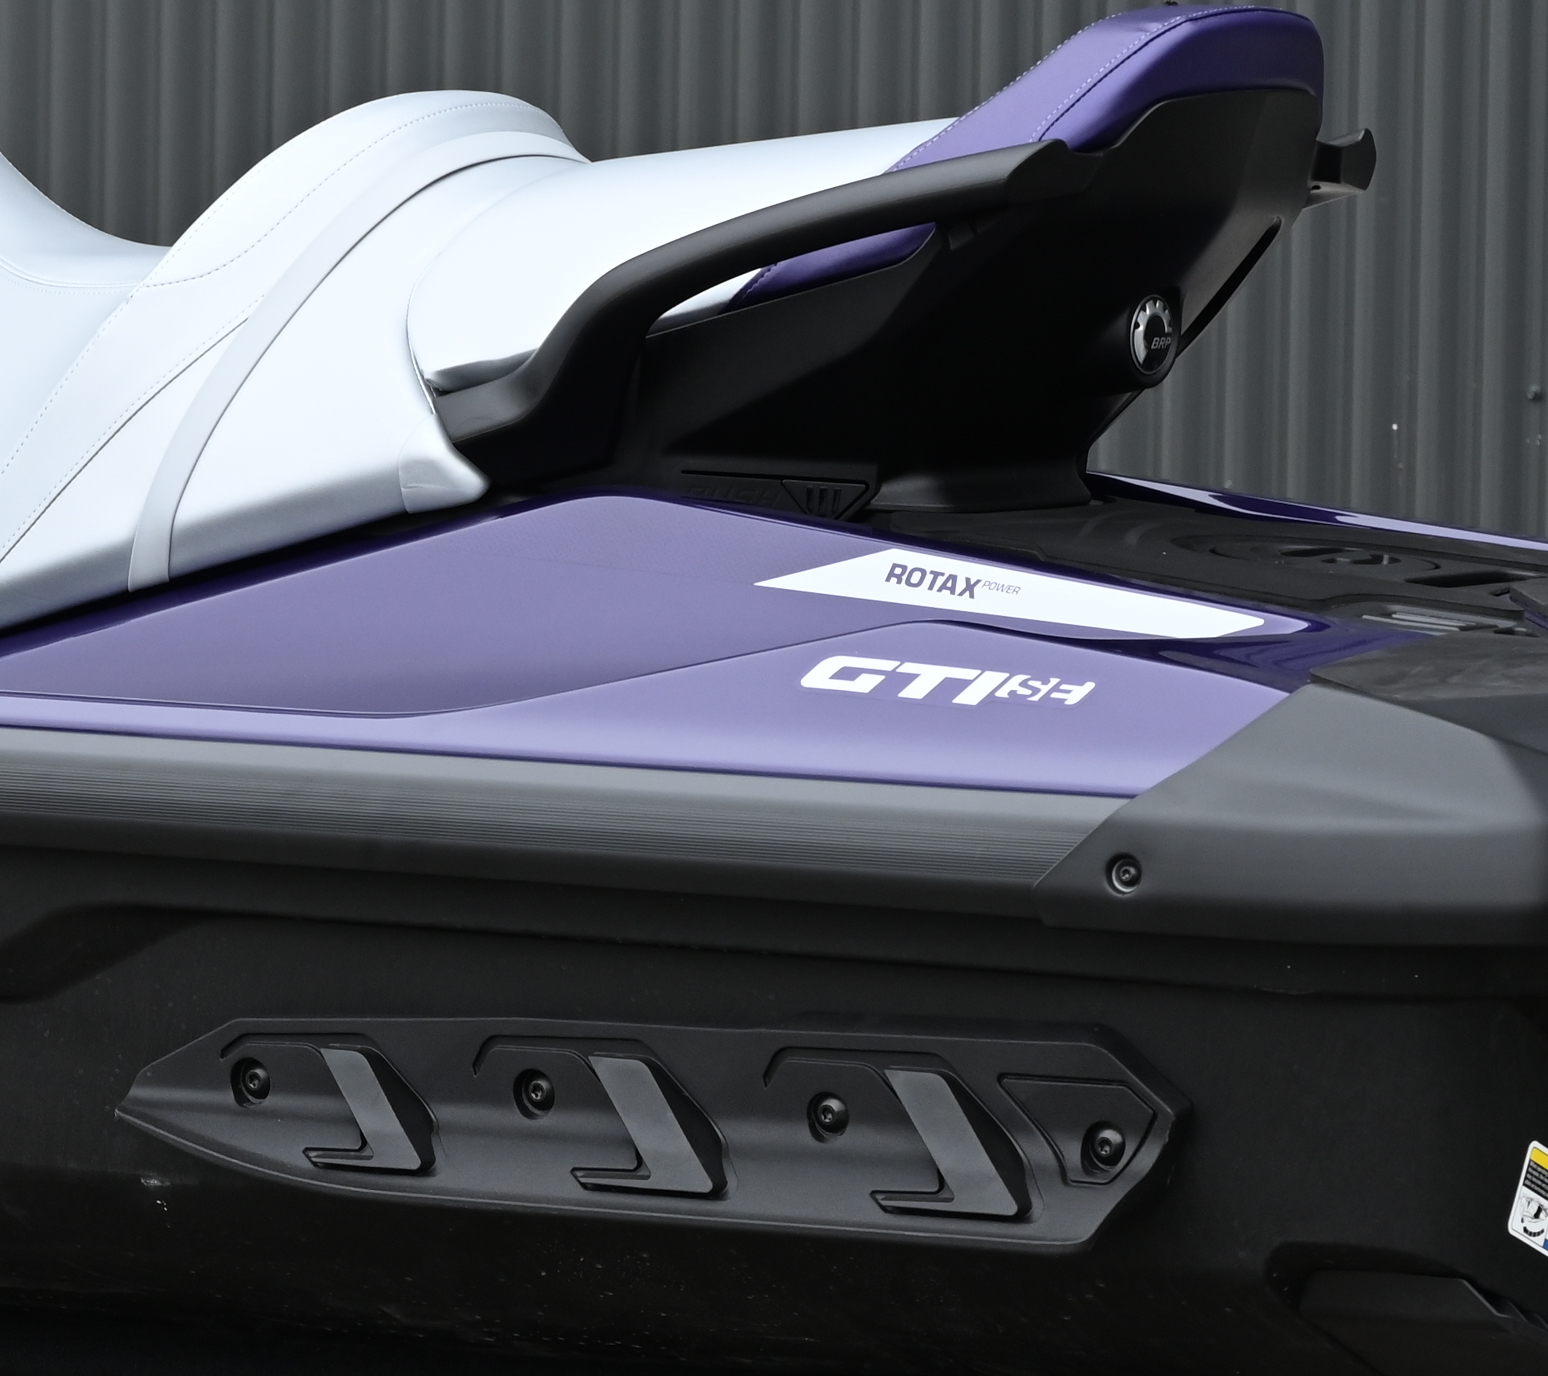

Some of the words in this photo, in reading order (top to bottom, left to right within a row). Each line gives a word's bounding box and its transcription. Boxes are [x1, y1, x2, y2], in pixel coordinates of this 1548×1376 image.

[1151, 336, 1172, 349] BRP
[884, 562, 983, 599] ROTAX
[981, 579, 1021, 596] POWER
[800, 655, 1010, 705] GTI
